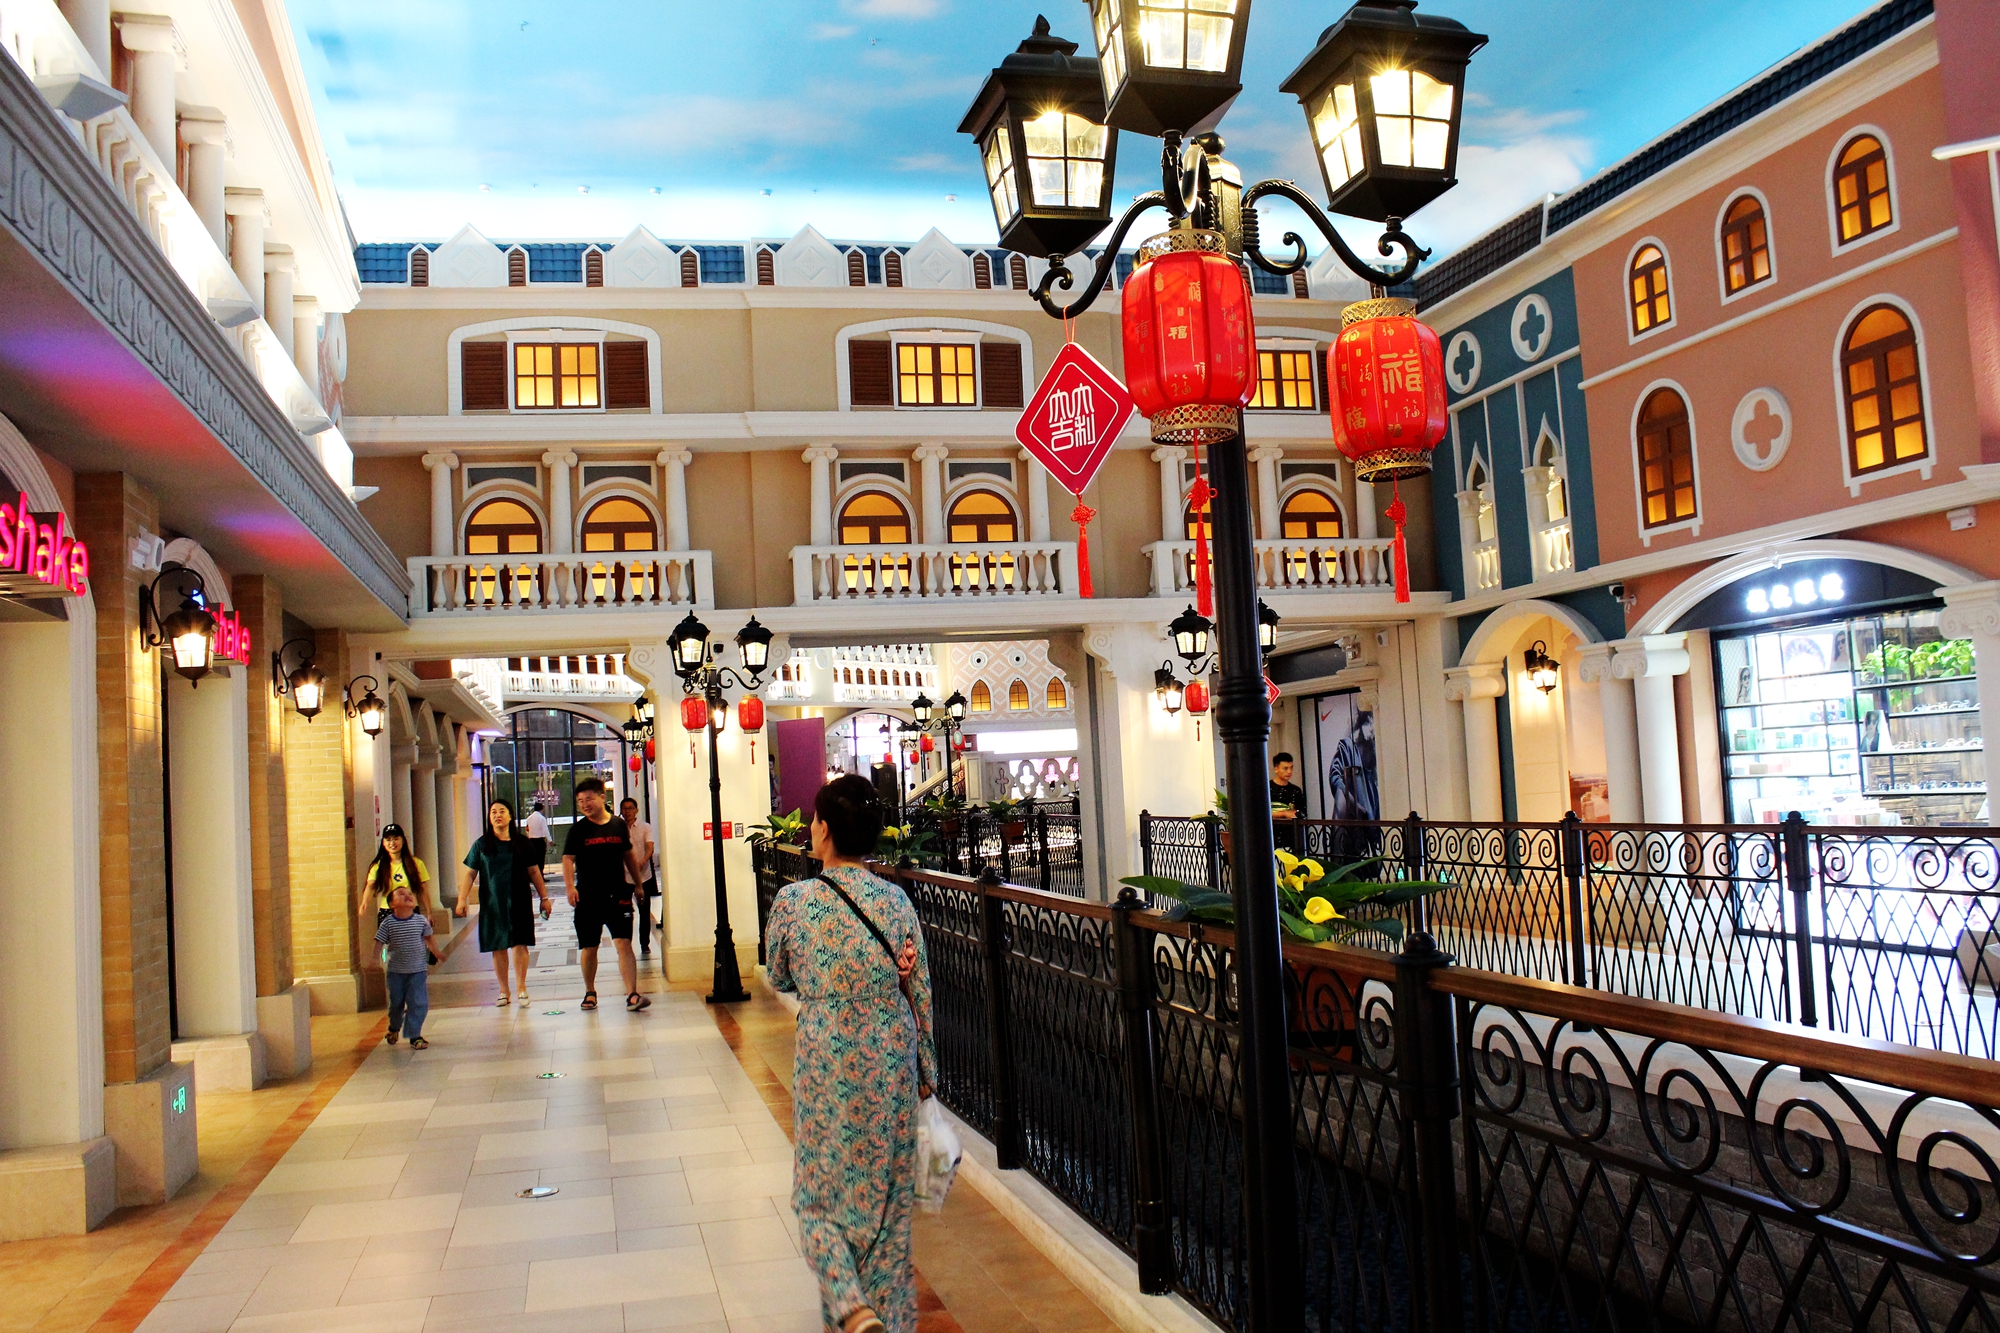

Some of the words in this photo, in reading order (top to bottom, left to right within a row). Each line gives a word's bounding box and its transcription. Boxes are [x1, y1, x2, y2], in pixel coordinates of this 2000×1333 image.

[1168, 325, 1188, 340] 福
[1359, 363, 1373, 383] 福
[1379, 349, 1422, 394] 福
[1346, 406, 1367, 431] 福
